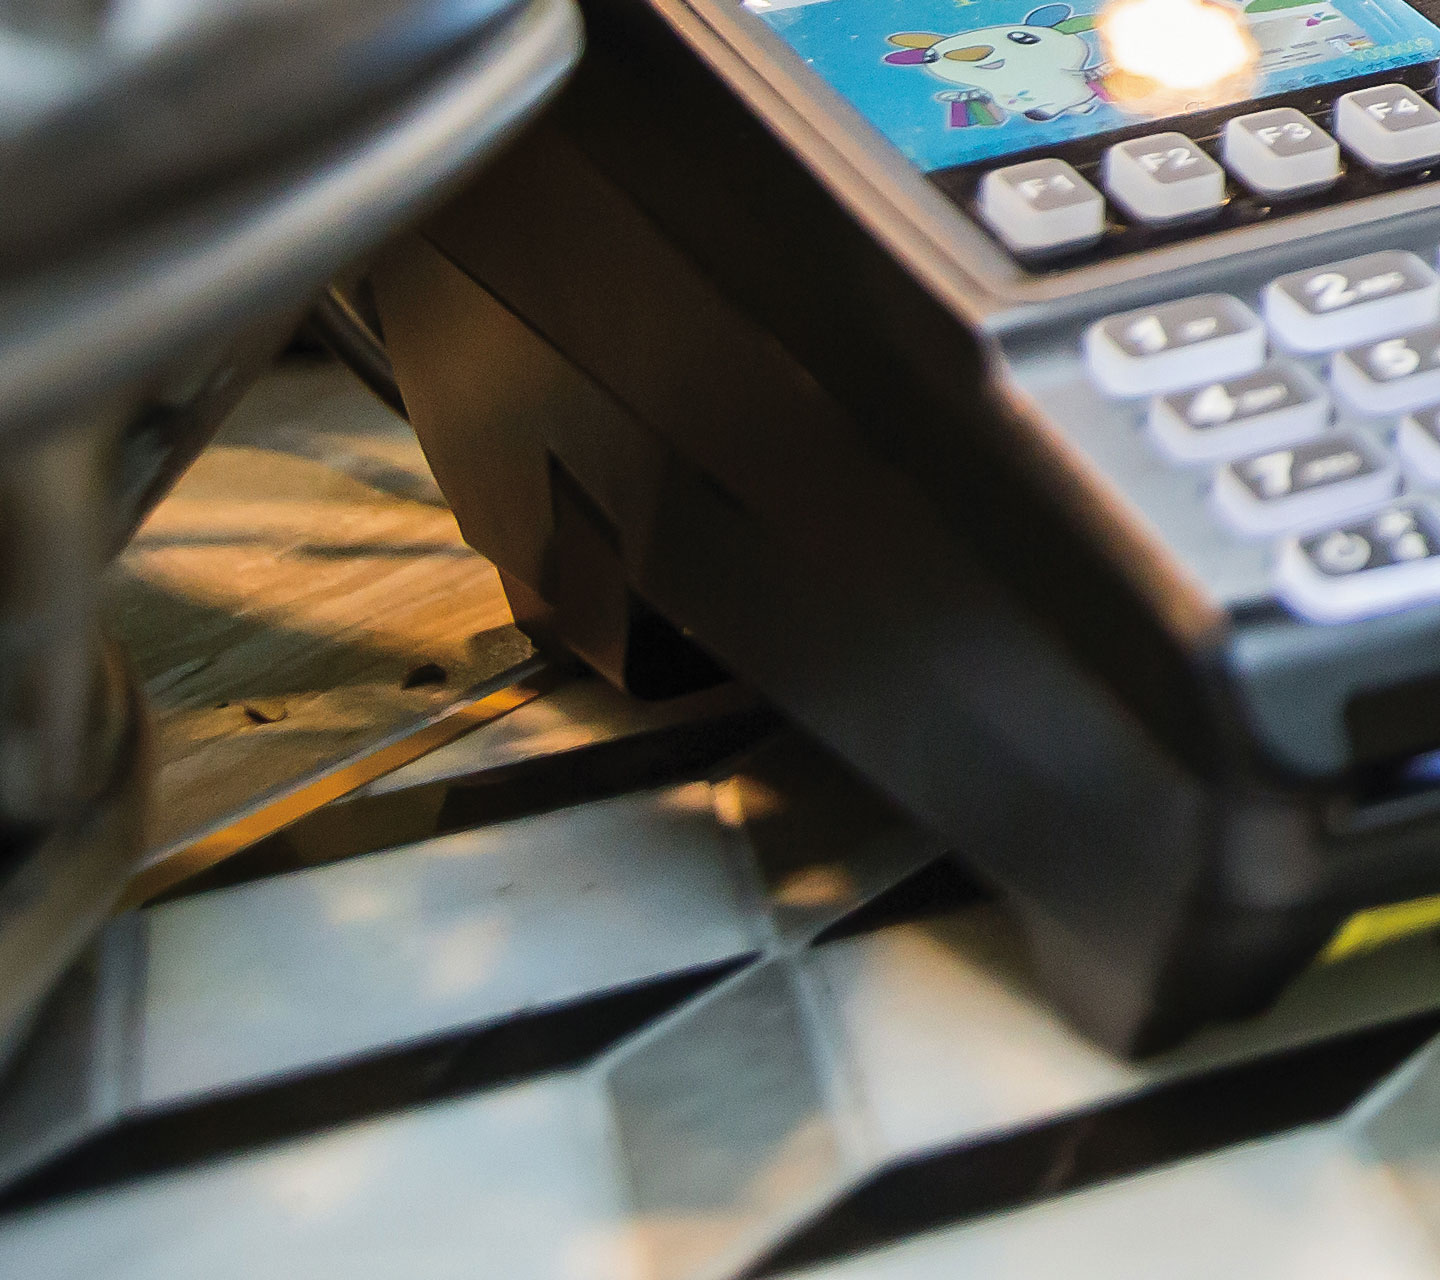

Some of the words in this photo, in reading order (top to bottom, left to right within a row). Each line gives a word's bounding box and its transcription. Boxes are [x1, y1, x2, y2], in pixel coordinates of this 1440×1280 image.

[1014, 173, 1076, 199] F1
[1139, 147, 1200, 173] F2
[1256, 122, 1313, 146] F3
[1366, 97, 1421, 121] F4
[1304, 272, 1354, 312] 2
[1250, 450, 1295, 497] 7
